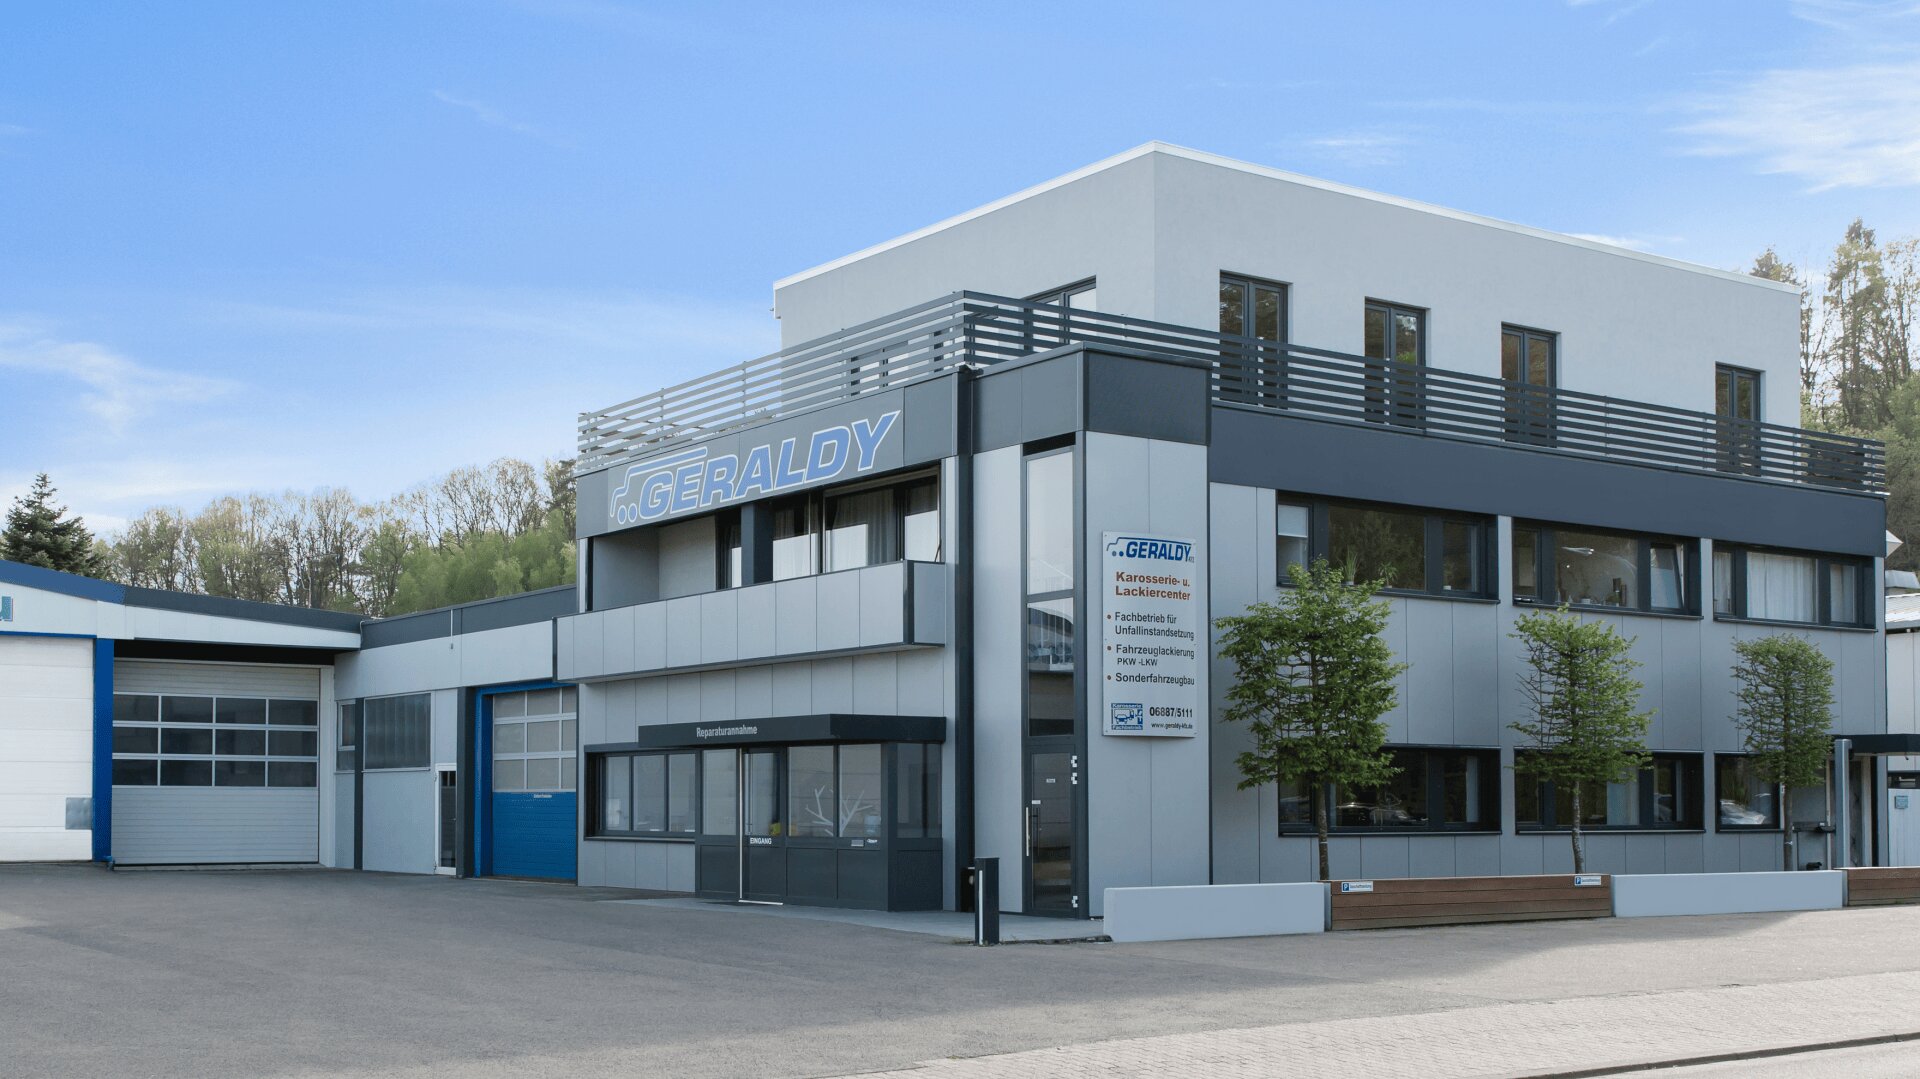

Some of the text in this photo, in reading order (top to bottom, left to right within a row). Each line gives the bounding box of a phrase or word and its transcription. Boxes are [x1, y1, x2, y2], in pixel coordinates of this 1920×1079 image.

[639, 410, 901, 520] GERALDY
[1126, 541, 1191, 562] GERALDY
[1116, 571, 1190, 587] Karosserie- u.
[1115, 585, 1190, 600] Lackiercenter
[1115, 612, 1177, 624] Fachbetrieb für
[1115, 625, 1194, 641] Unfallinstandsetzung
[1116, 644, 1194, 660] Fahrzeuglackierung
[1117, 657, 1136, 666] PKW
[1115, 672, 1195, 686] Sonderfahrzeugbau
[1149, 706, 1193, 718] 06887/5111
[696, 724, 758, 739] Reparaturannahme
[750, 837, 772, 845] EINGANG
